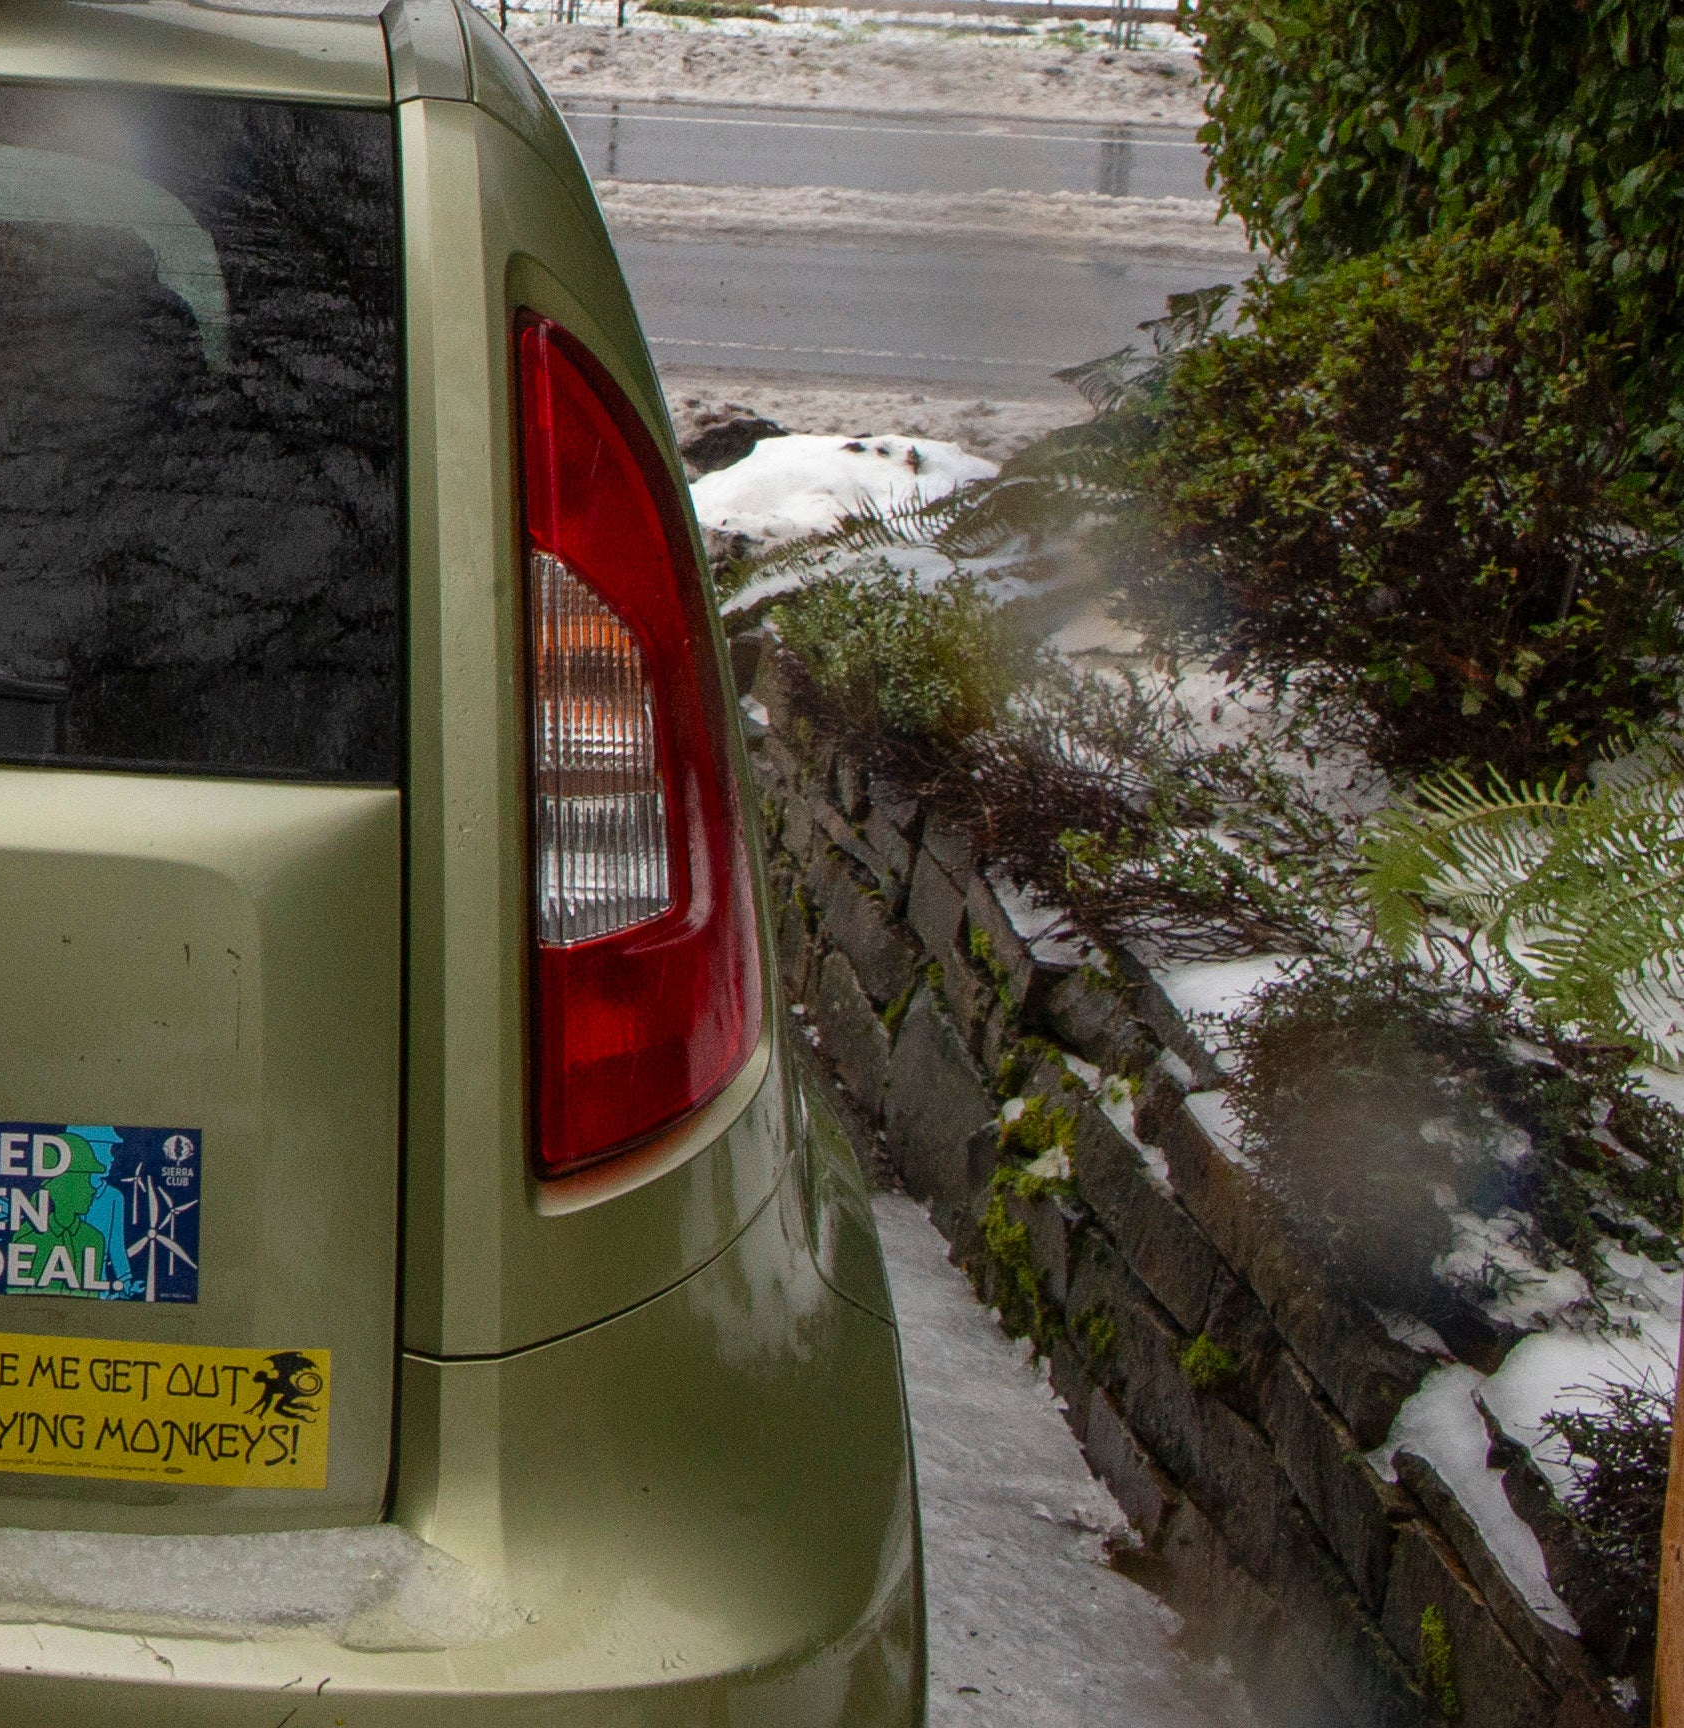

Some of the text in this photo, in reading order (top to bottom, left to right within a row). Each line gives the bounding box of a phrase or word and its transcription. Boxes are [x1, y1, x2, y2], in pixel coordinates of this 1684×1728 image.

[161, 1166, 195, 1177] SIERRA
[166, 1176, 189, 1187] CLUB
[28, 1355, 80, 1390] ME
[89, 1358, 161, 1402] GET
[166, 1363, 250, 1407] OUT
[94, 1416, 301, 1467] MONKEYS!
